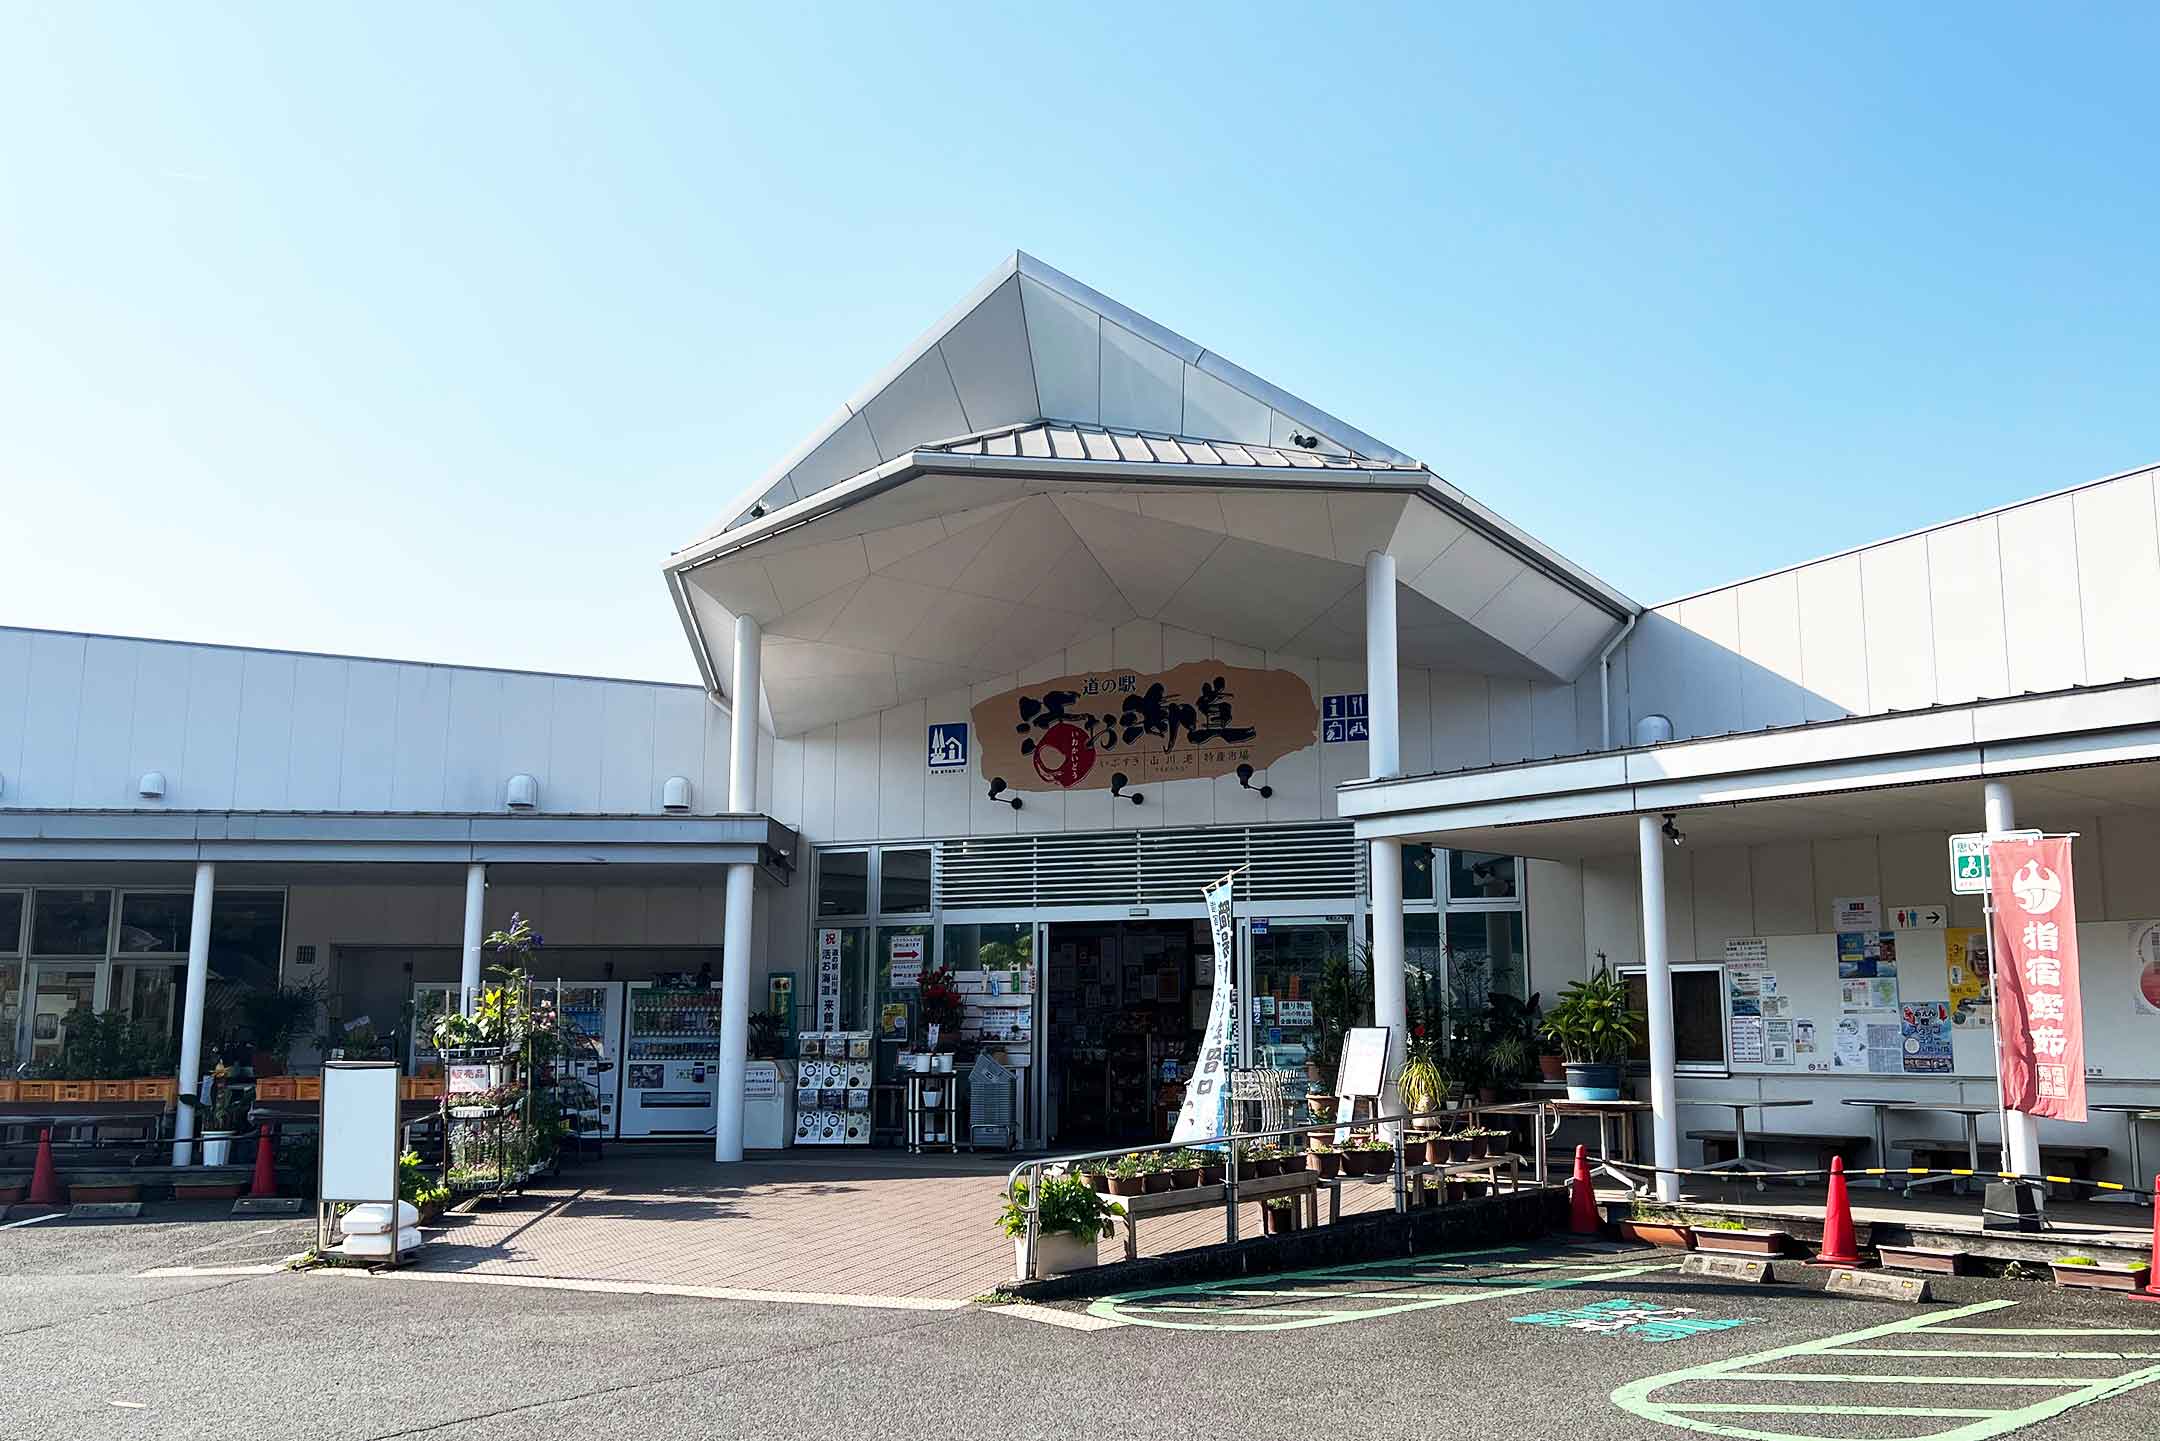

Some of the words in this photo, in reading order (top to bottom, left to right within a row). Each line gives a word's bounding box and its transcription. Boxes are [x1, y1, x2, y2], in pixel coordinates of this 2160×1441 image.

[1082, 675, 1137, 696] 道の駅
[825, 933, 836, 945] 祝
